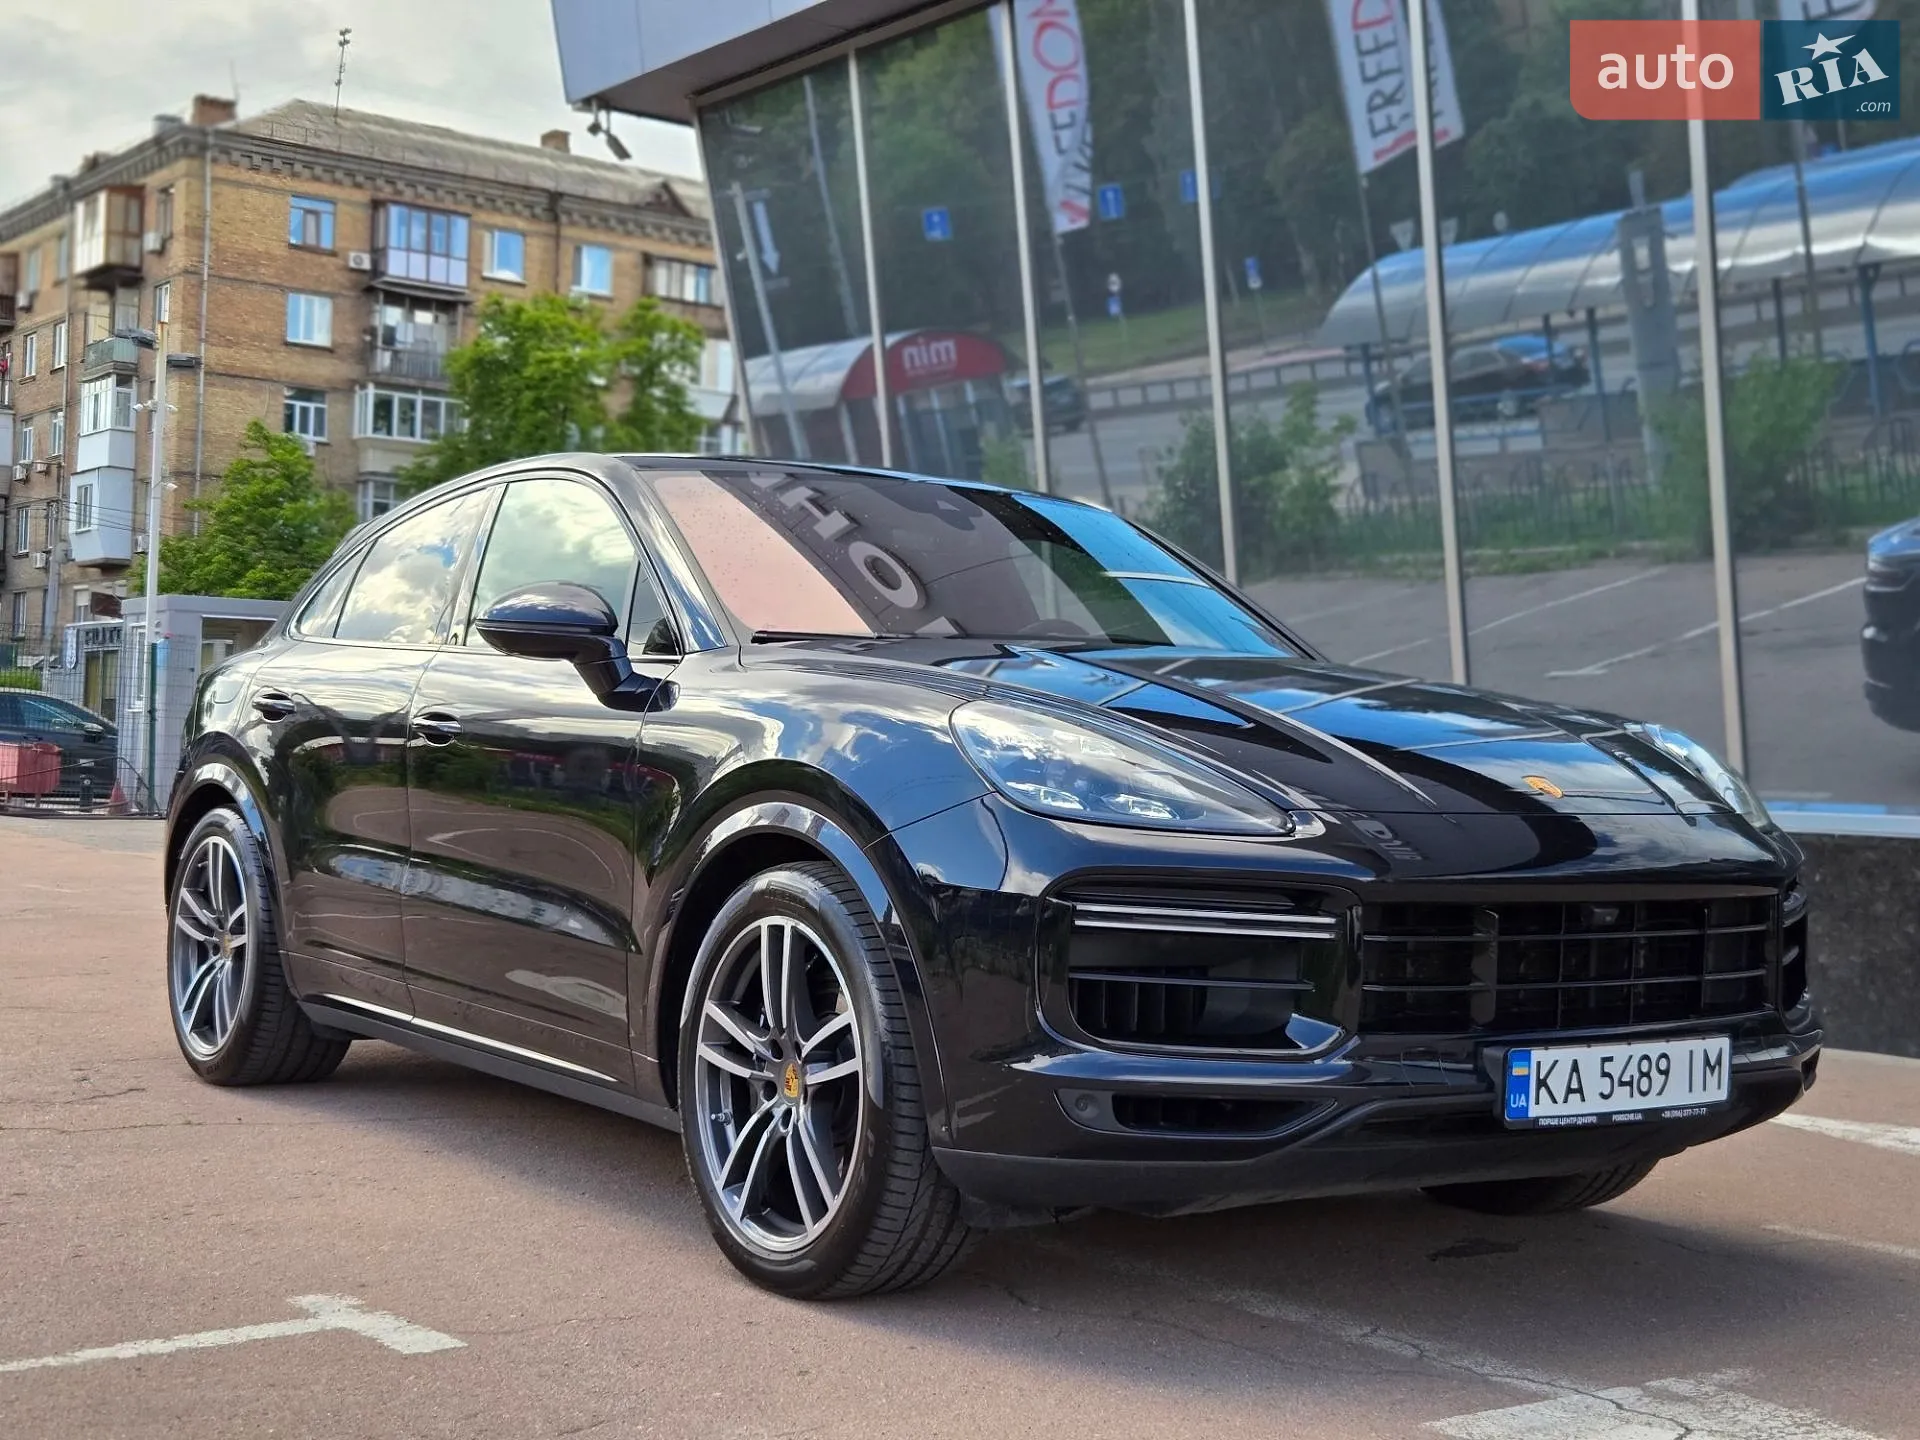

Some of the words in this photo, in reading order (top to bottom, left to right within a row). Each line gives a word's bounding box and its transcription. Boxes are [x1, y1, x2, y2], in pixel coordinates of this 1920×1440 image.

[1534, 1058, 1587, 1105] KA
[1599, 1051, 1672, 1101] 5489
[1510, 1093, 1527, 1108] UA
